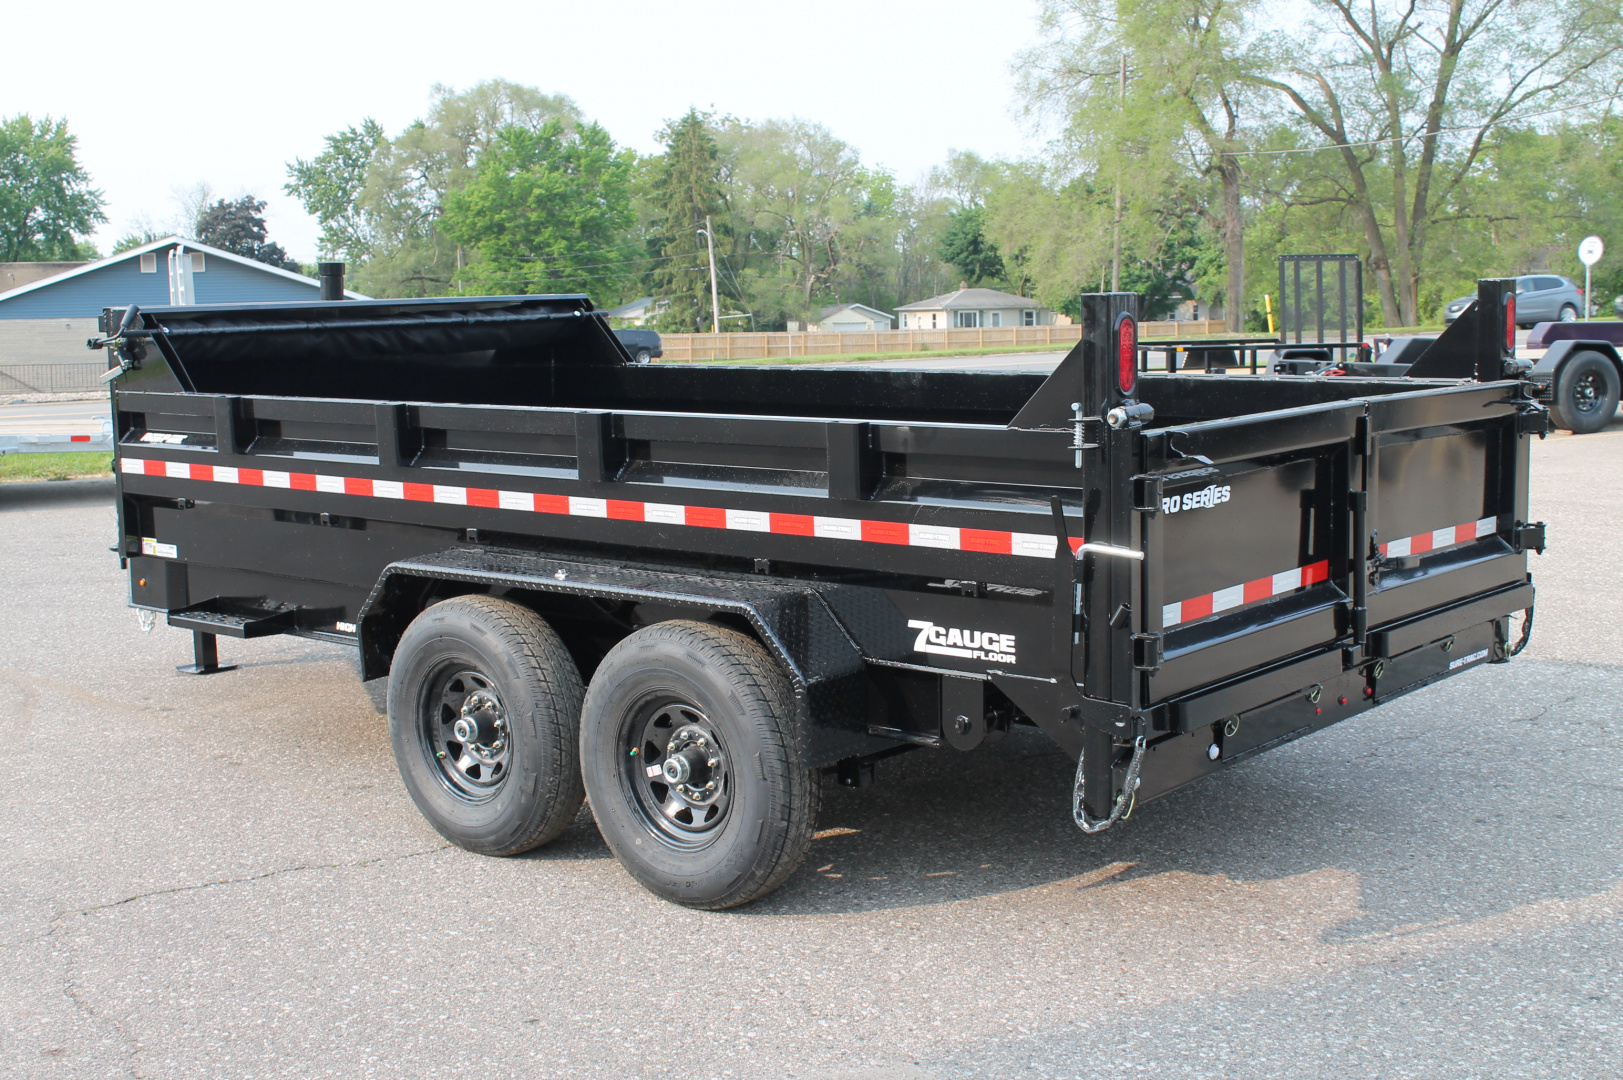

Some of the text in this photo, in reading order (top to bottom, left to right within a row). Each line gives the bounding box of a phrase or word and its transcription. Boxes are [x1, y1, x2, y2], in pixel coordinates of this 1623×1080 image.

[1162, 484, 1231, 515] RO SERIES
[907, 619, 1016, 653] 7 GAUGE
[973, 650, 1017, 664] FLOOR
